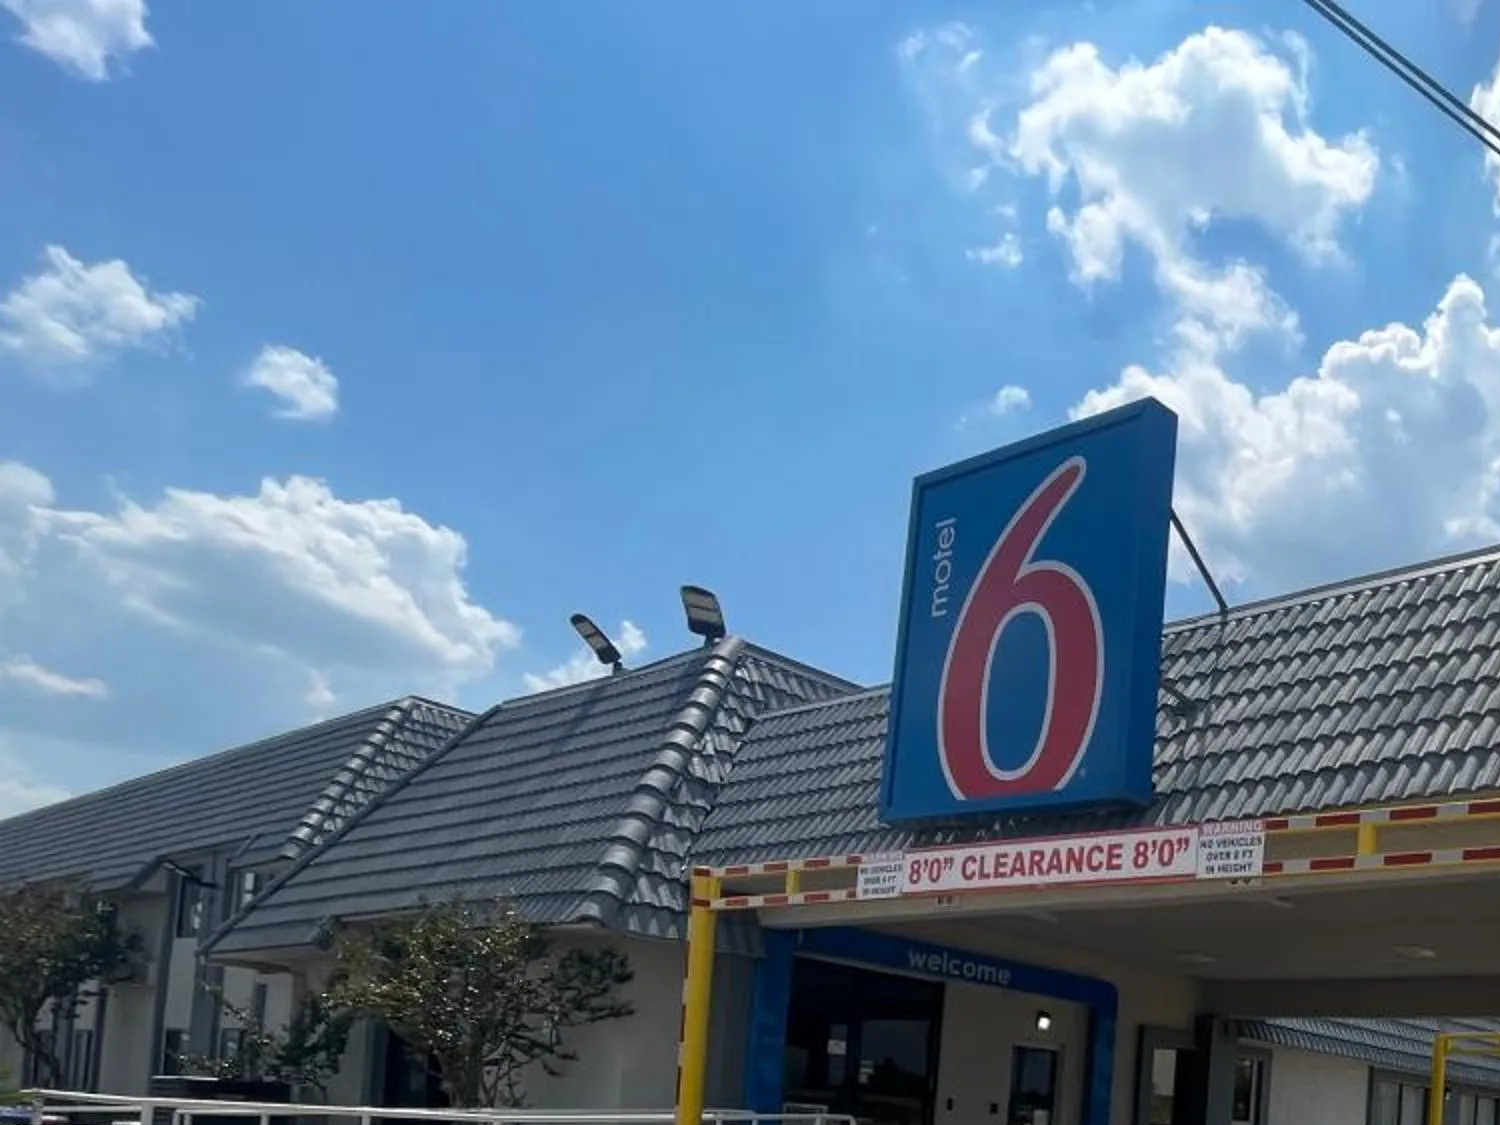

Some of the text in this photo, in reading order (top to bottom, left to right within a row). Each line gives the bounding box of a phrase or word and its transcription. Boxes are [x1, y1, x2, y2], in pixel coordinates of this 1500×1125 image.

[932, 517, 958, 619] motel
[937, 455, 1105, 801] 6
[961, 843, 1124, 881] CLEARANCE
[907, 948, 1012, 985] welcome
